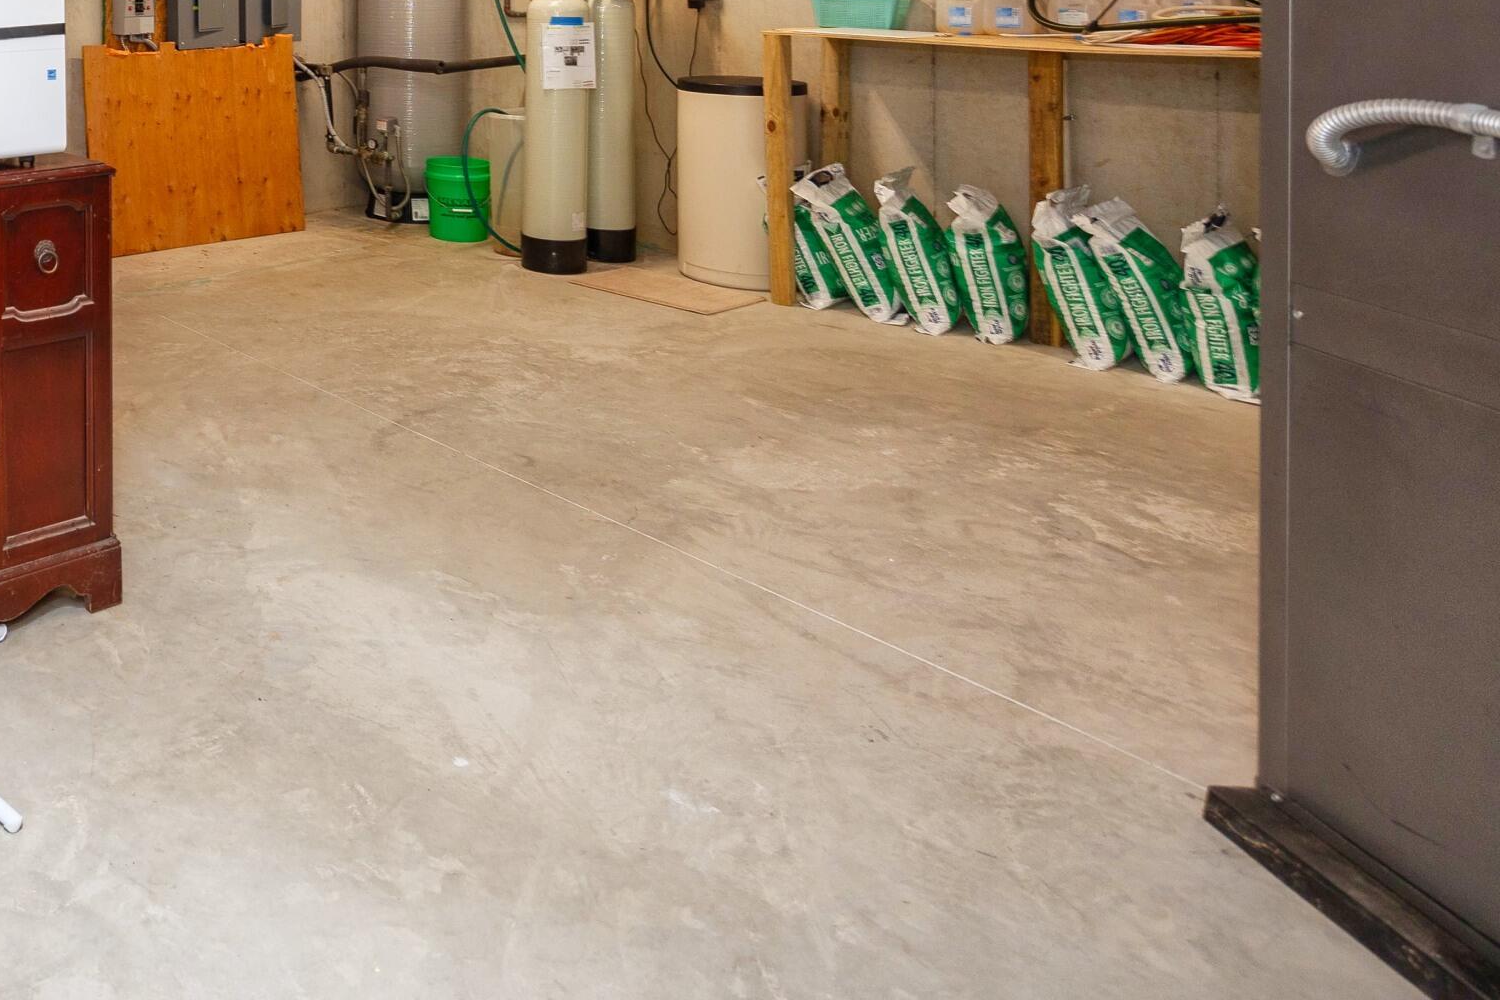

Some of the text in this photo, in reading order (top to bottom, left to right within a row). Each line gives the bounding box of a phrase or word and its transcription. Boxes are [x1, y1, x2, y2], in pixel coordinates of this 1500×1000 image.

[830, 233, 848, 254] IRON
[842, 252, 865, 288] FIGHTER
[898, 238, 923, 278] FIGHTER
[969, 248, 994, 286] FIGHTER
[1109, 256, 1130, 277] 40
[912, 275, 932, 297] IRON
[980, 285, 1000, 308] IRON
[1056, 262, 1085, 304] FIGHTER
[1119, 276, 1153, 316] FIGHTER
[1070, 302, 1093, 329] IRON
[1199, 292, 1222, 318] IRON
[1138, 314, 1166, 341] IRON
[1205, 318, 1231, 361] FIGHTER
